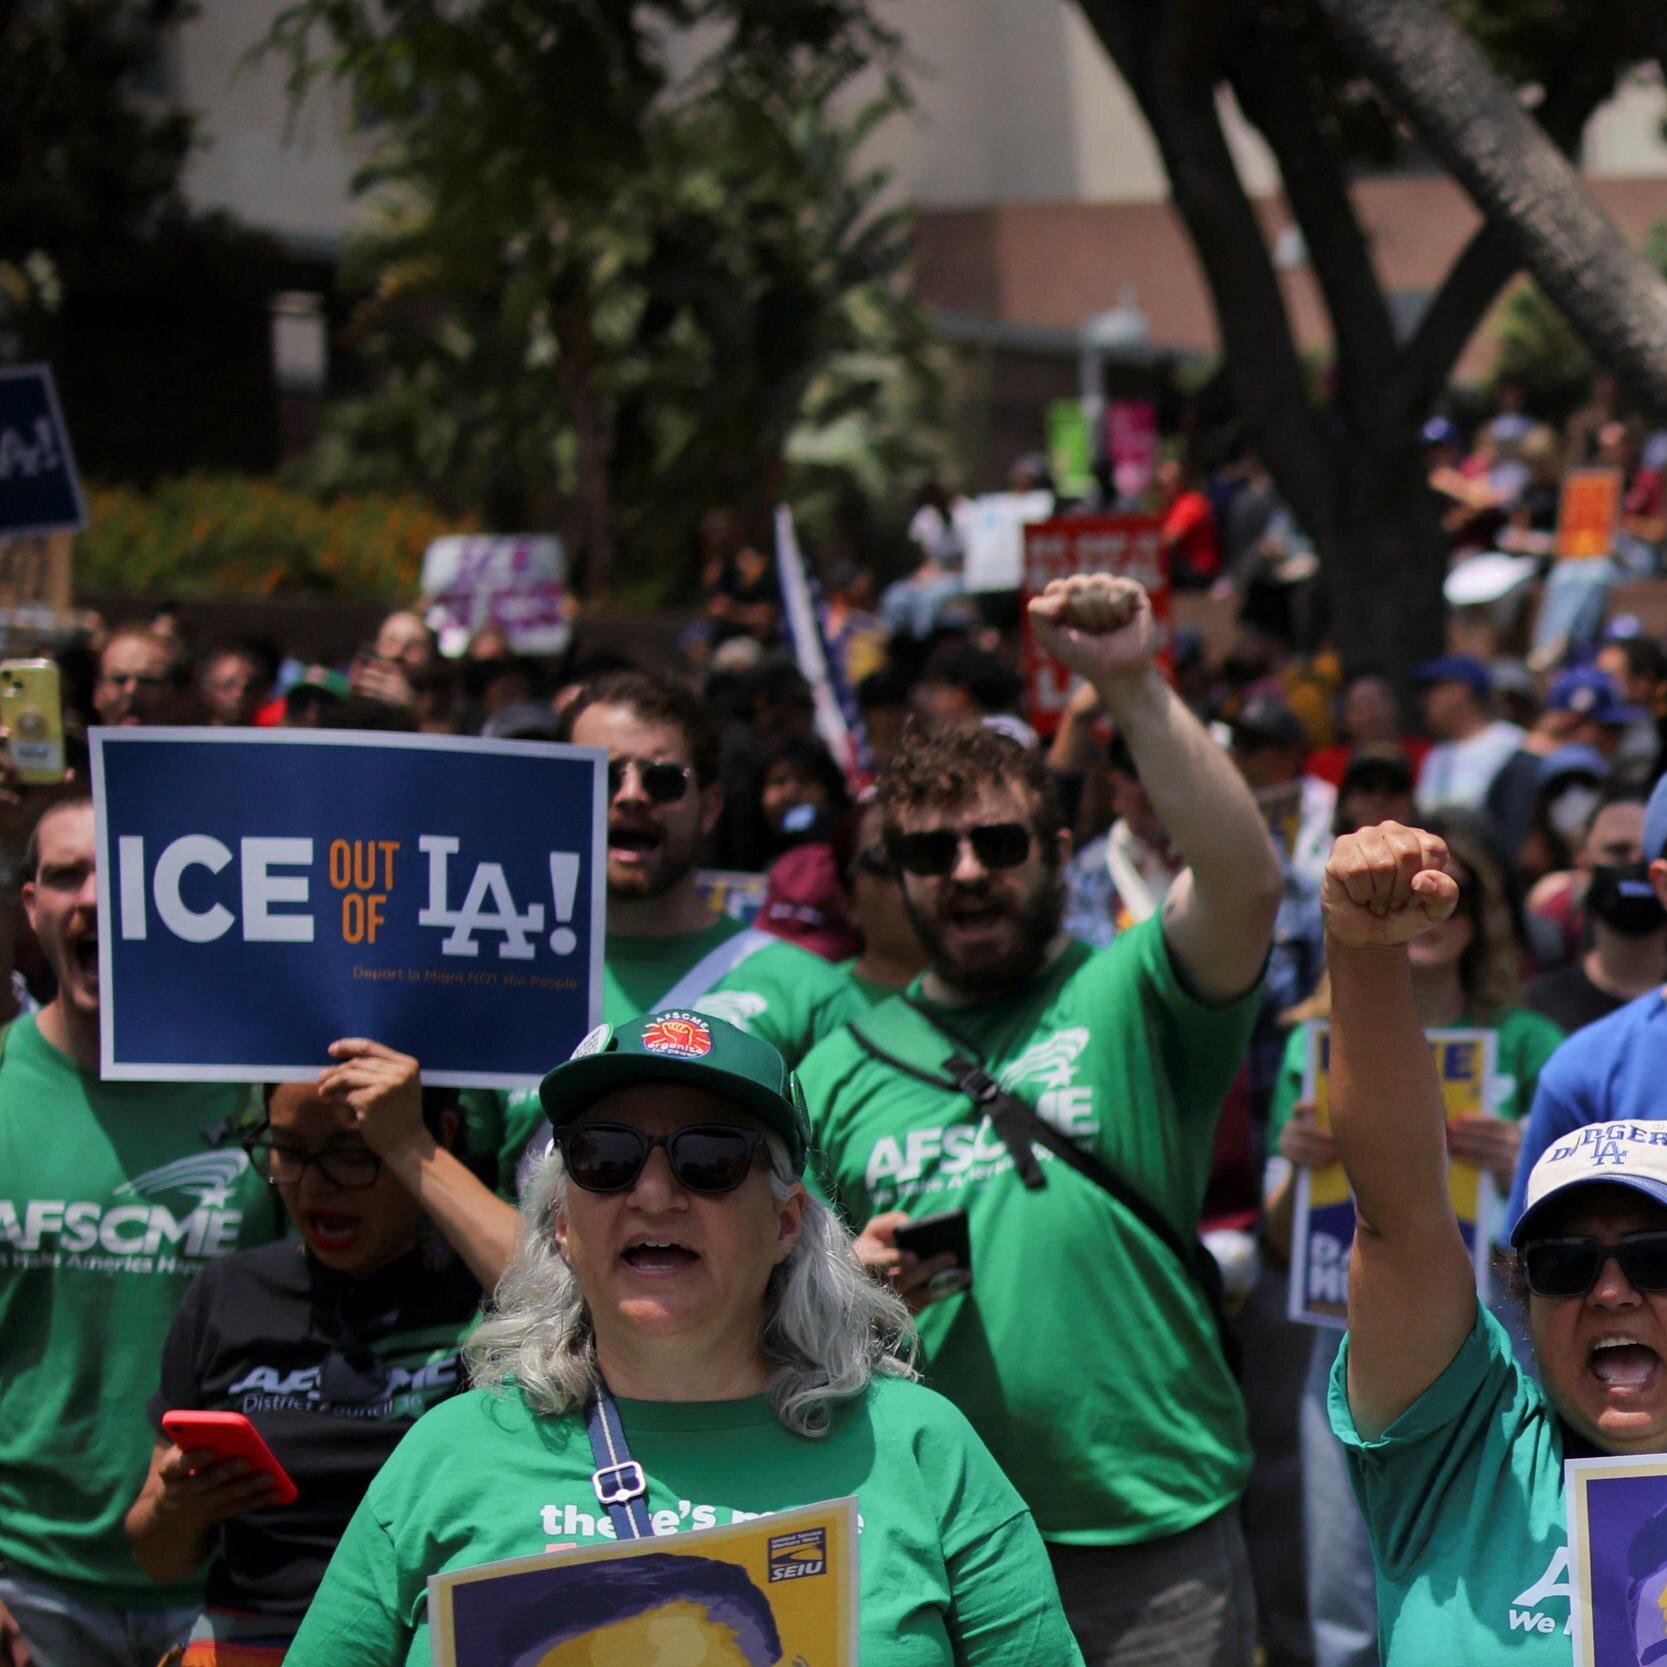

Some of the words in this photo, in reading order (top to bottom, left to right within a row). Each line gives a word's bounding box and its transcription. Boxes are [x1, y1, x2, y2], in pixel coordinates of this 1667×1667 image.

[118, 834, 315, 943] ICE
[328, 838, 400, 891] OUT
[342, 893, 388, 945] OF
[418, 834, 581, 960] LA!
[656, 1011, 710, 1030] AFSCME
[771, 1561, 824, 1581] SEIU
[1508, 1608, 1556, 1633] We
